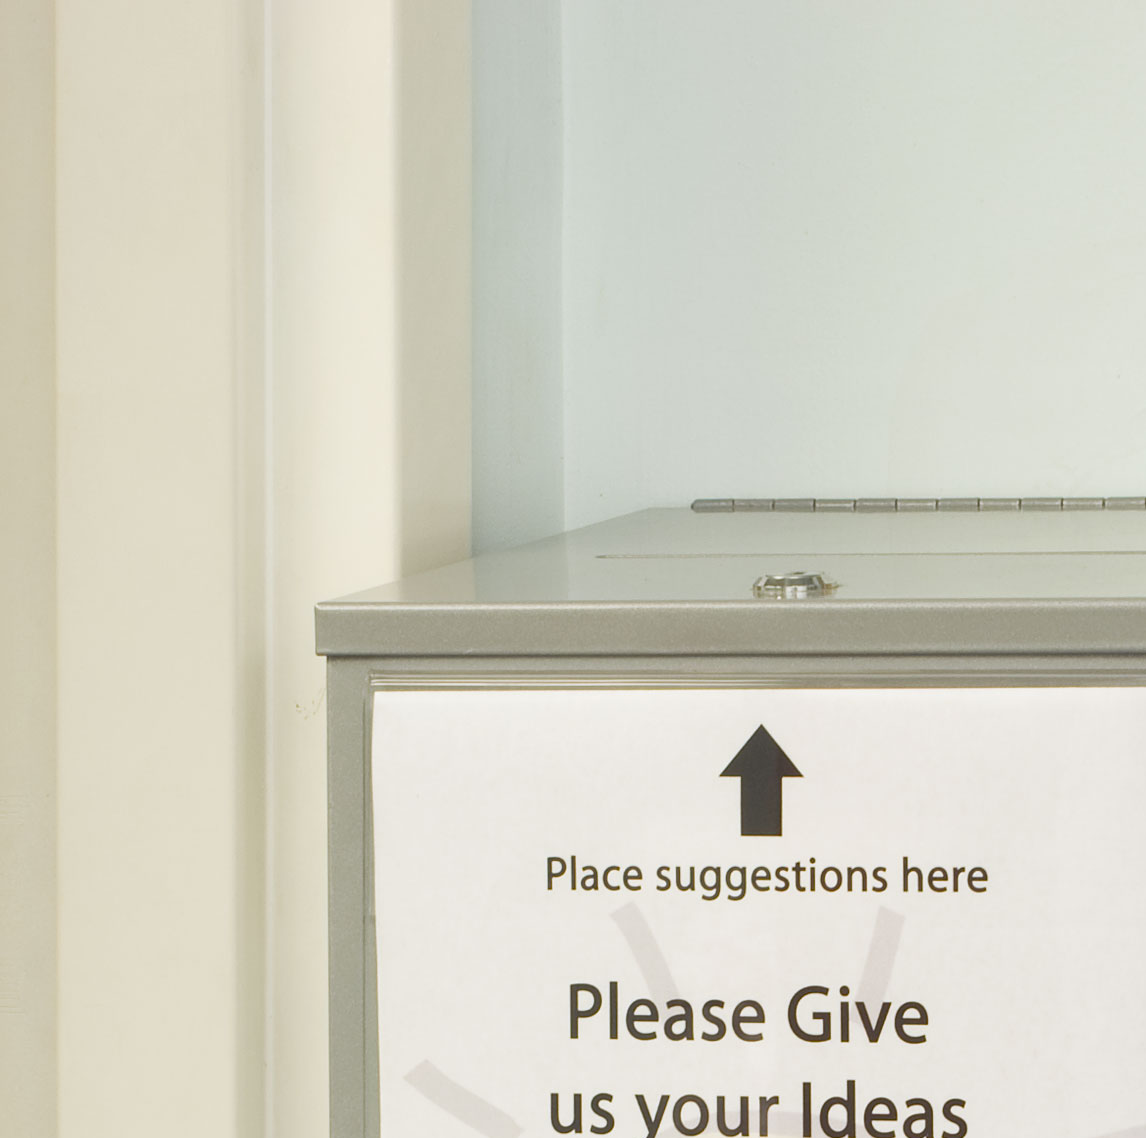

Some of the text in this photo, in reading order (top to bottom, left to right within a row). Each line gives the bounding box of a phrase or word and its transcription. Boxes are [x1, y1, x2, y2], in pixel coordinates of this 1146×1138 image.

[547, 855, 989, 902] Place suggestions here
[570, 982, 930, 1045] Please Give
[550, 1092, 616, 1136] us
